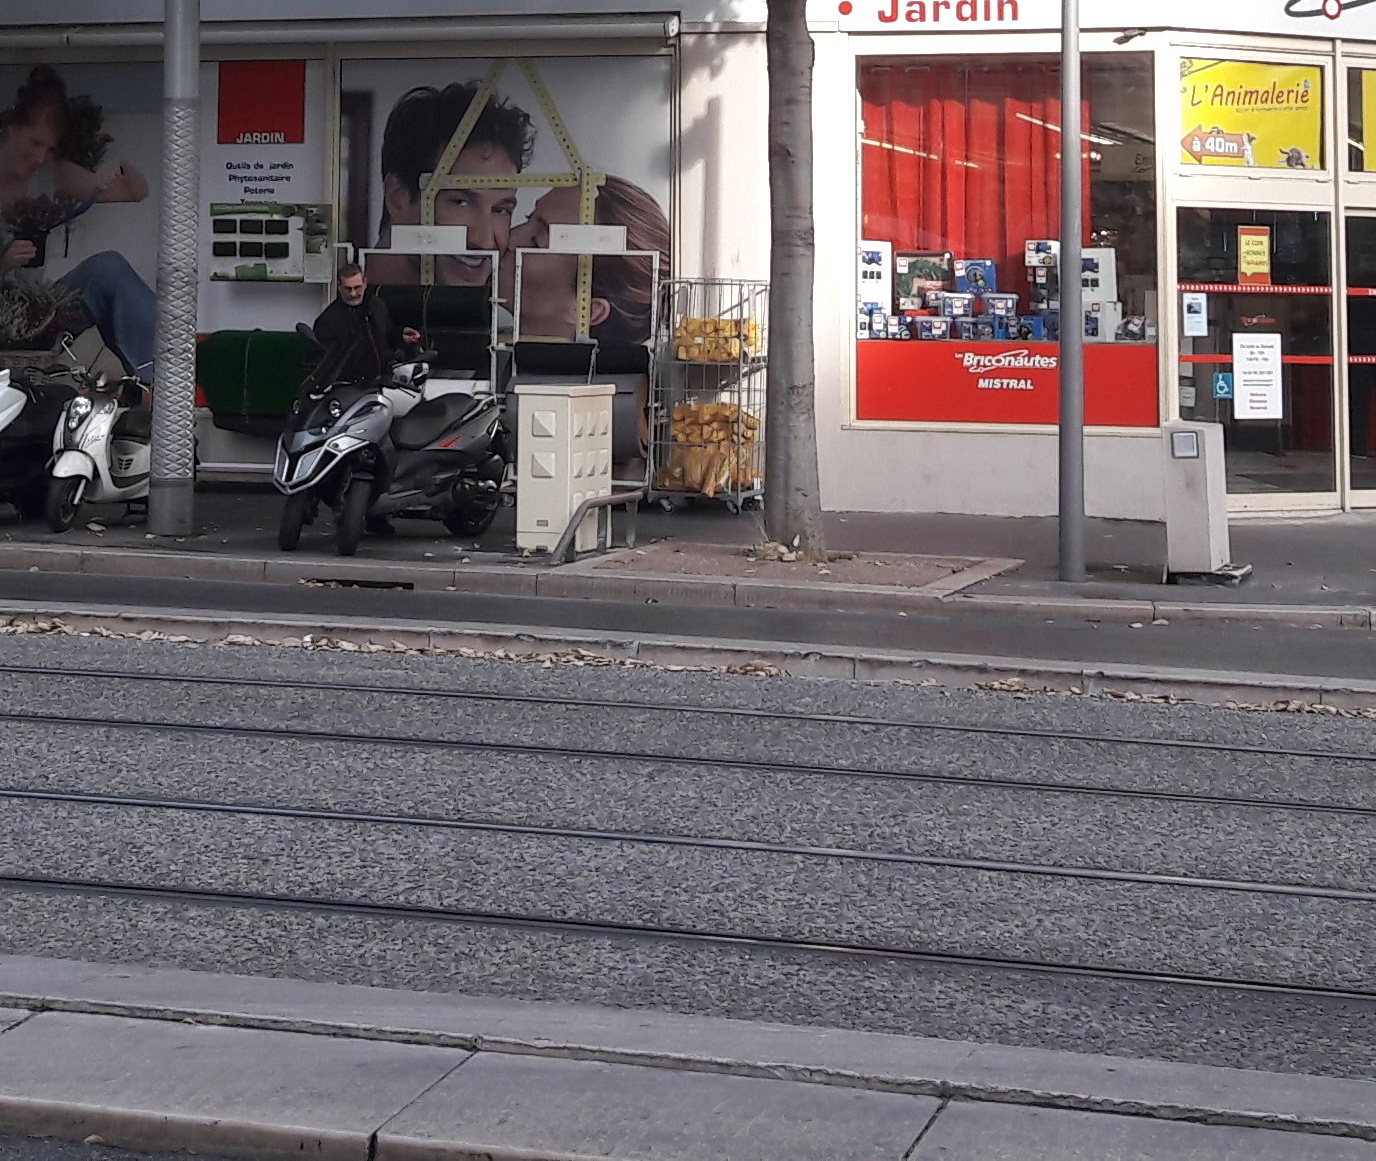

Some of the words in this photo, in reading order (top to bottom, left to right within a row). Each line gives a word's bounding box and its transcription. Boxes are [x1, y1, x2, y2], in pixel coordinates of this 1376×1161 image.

[1190, 81, 1310, 107] L'Animalerie
[236, 132, 285, 144] JARDIN
[1192, 136, 1201, 152] à
[1205, 137, 1238, 153] 40m
[962, 352, 1058, 369] Briconautes
[977, 378, 1034, 390] MISTRAL
